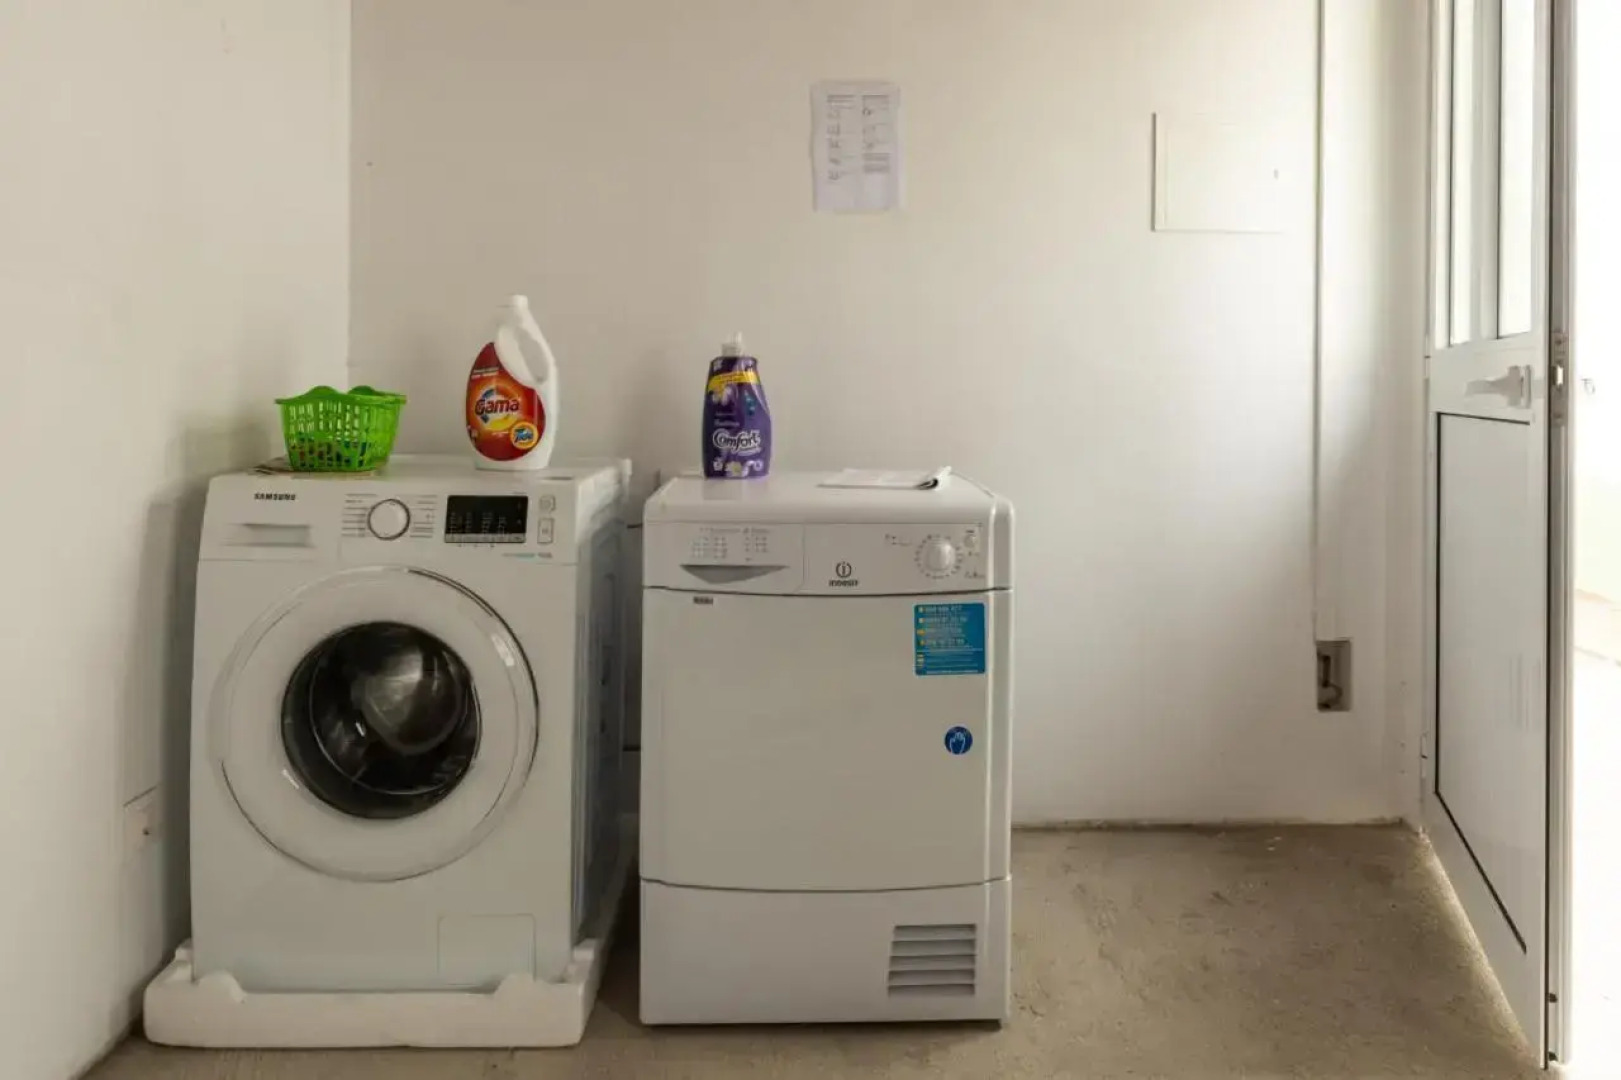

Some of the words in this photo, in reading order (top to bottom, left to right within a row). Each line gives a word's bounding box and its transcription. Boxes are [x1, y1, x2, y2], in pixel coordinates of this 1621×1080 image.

[475, 399, 520, 415] Gama
[713, 430, 761, 451] Comfort
[254, 493, 296, 501] SAMSUNG
